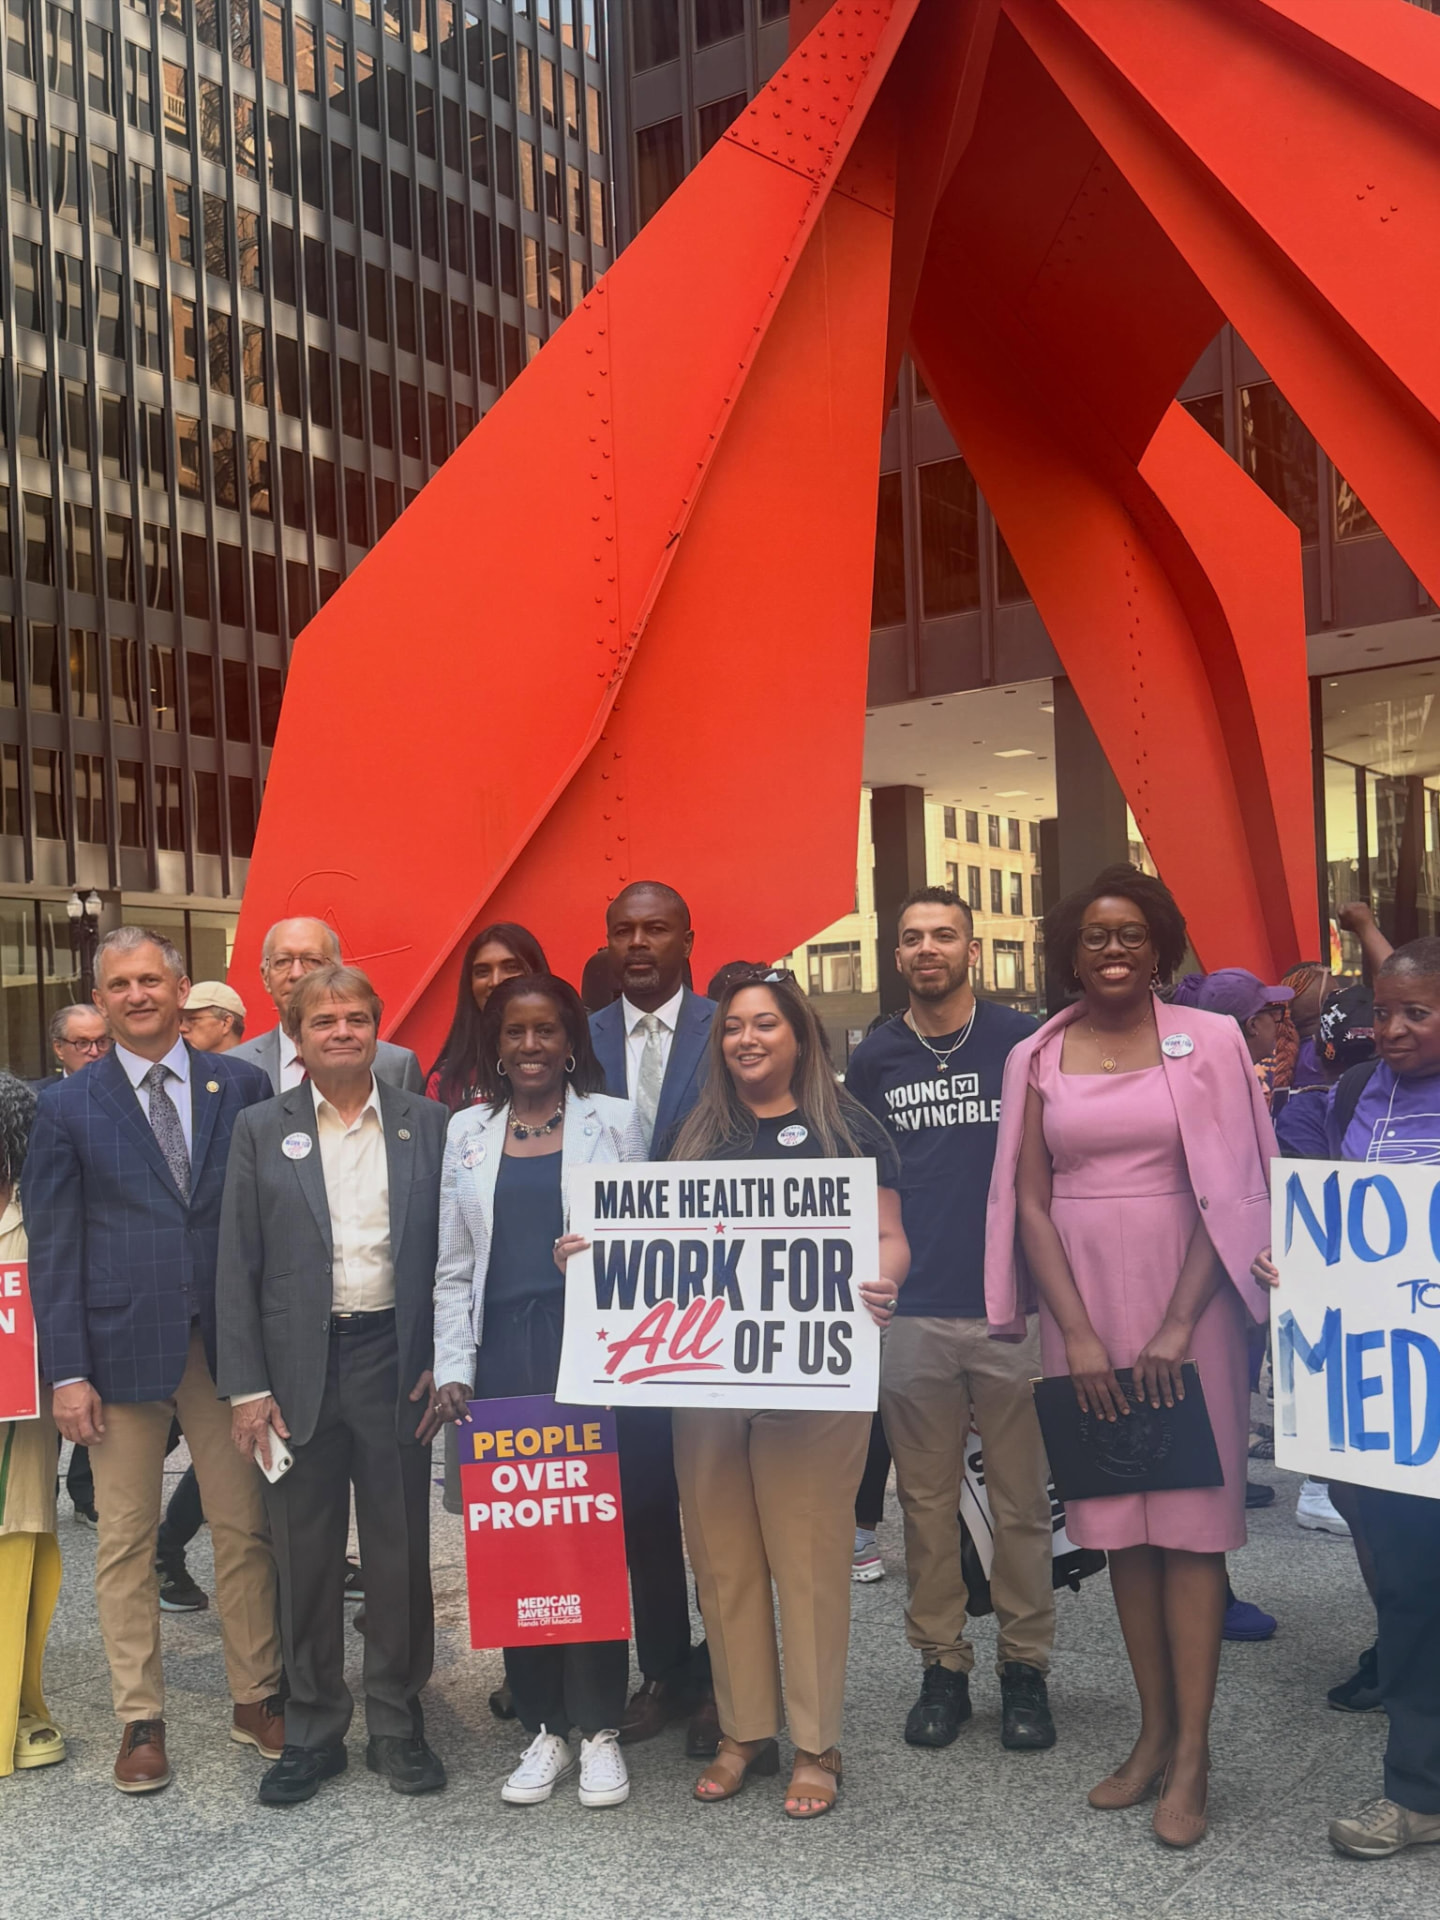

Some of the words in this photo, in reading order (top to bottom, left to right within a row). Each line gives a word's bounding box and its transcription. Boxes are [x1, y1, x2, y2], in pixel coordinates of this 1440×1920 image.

[884, 1079, 950, 1110] YOUNG
[956, 1080, 973, 1092] YI
[594, 1179, 670, 1219] MAKE
[678, 1177, 775, 1218] HEALTH
[783, 1176, 851, 1217] CARE
[1285, 1170, 1408, 1267] NO
[0, 1271, 22, 1298] E
[592, 1238, 746, 1311] WORK
[759, 1237, 855, 1313] FOR
[603, 1297, 725, 1376] All
[733, 1319, 786, 1375] OF
[798, 1319, 853, 1376] US
[472, 1422, 603, 1460] PEOPLE
[491, 1459, 589, 1494] OVER
[468, 1493, 618, 1532] PROFITS
[517, 1594, 581, 1609] MEDICAID
[518, 1607, 550, 1619] SAVES
[551, 1605, 582, 1617] LIVES
[551, 1614, 583, 1625] Medicaid
